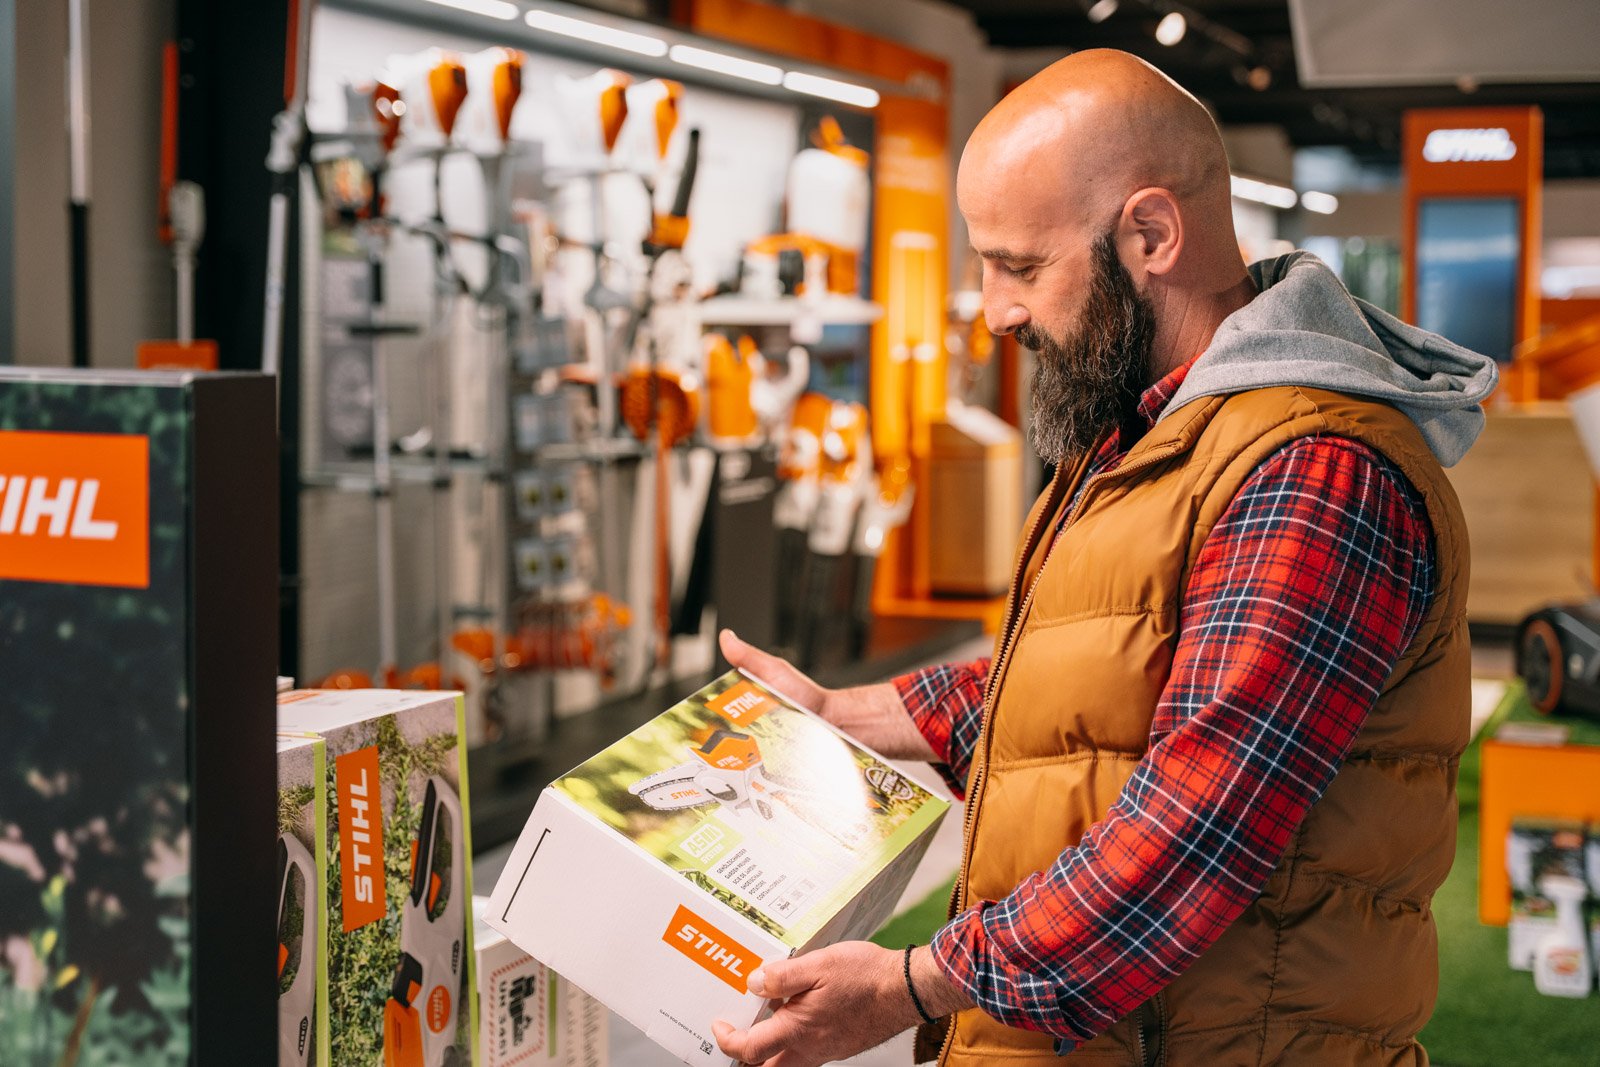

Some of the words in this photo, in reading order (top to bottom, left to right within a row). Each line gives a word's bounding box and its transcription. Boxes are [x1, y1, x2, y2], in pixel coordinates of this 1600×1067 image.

[0, 475, 118, 541] IHL
[723, 691, 765, 719] STIHL
[671, 789, 699, 800] STIHL
[350, 769, 374, 904] STIHL
[724, 865, 739, 880] GARDEN
[732, 876, 741, 885] SCIE
[676, 924, 743, 977] STIHL
